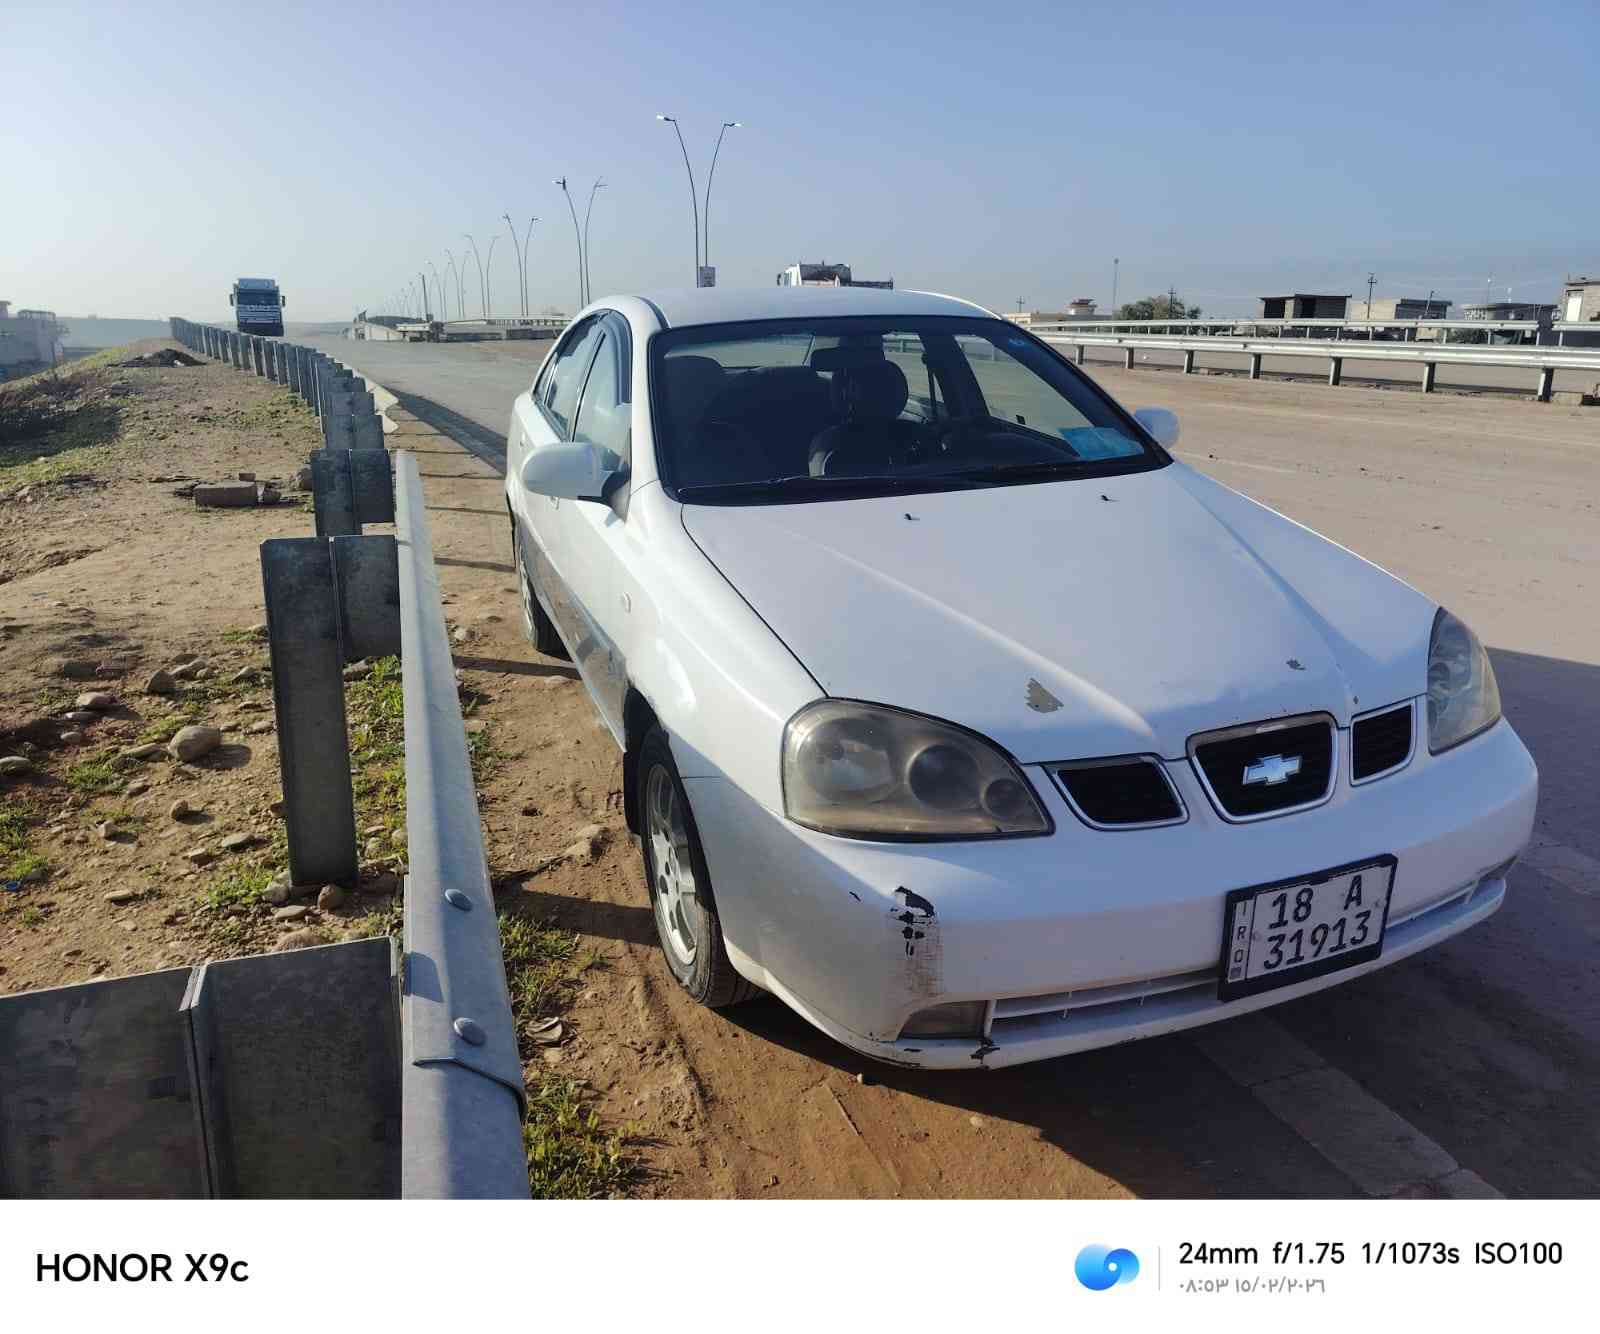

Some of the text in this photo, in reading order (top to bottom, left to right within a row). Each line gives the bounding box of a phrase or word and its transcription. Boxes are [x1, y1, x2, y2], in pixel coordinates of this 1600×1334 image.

[1268, 875, 1363, 930] 18 A
[1263, 910, 1372, 969] 31913
